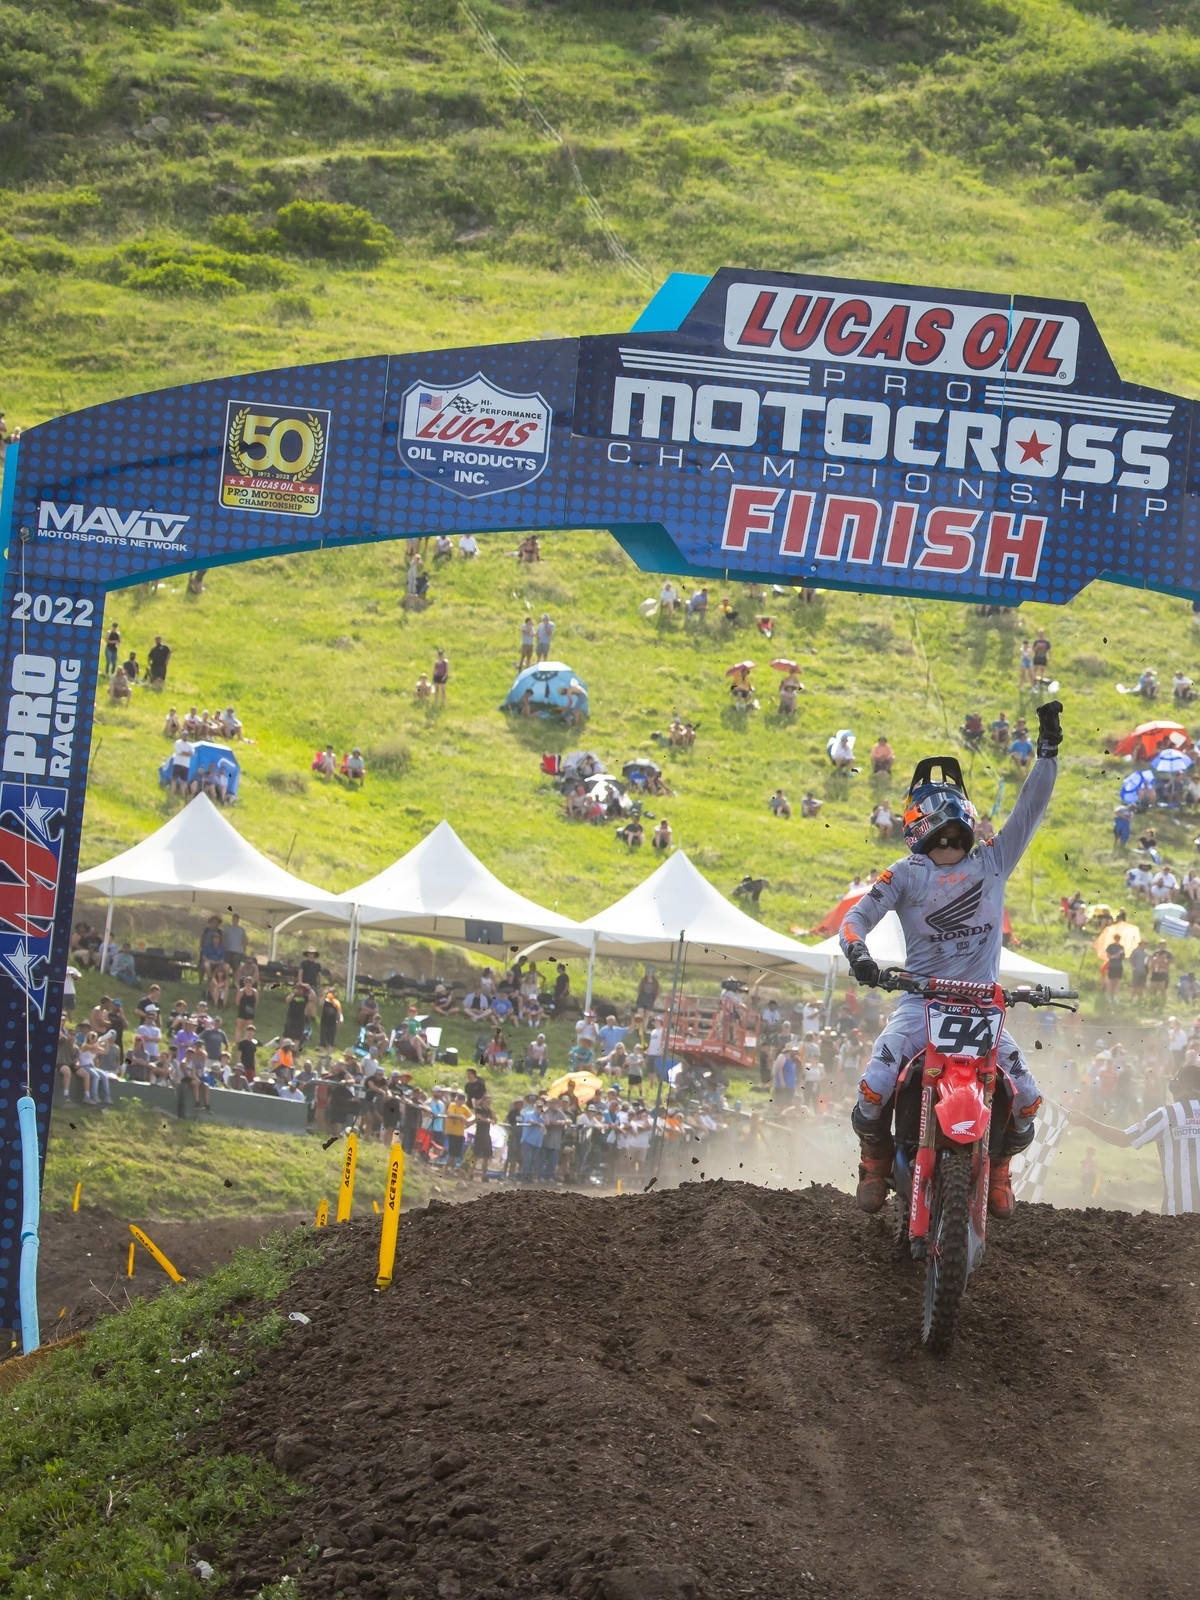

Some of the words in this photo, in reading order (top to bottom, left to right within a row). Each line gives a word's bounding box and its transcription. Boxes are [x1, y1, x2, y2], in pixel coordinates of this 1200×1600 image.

[737, 290, 955, 366] LUCAS
[962, 313, 1065, 378] OIL
[824, 368, 972, 402] PRO
[415, 413, 538, 447] LUCAS
[479, 407, 542, 420] PERFORMANCE
[610, 376, 1174, 490] MOTOCROSS
[239, 414, 315, 474] 50
[407, 446, 437, 461] OIL
[442, 449, 537, 471] PRODUCTS
[227, 487, 249, 497] PRO
[251, 489, 316, 504] MOTOCROSS
[250, 479, 280, 490] LUCAS
[280, 483, 294, 492] OIL
[607, 441, 1168, 517] CHAMPIONSHIP
[238, 497, 303, 511] CHAMPIONSHIP
[37, 529, 127, 546] MOTORSPORTS
[130, 538, 188, 552] NETWORK
[721, 484, 1048, 583] FINISH
[11, 592, 95, 628] 2022
[2, 653, 57, 776] PRO
[49, 658, 82, 779] RACING
[928, 922, 993, 943] HONDA
[935, 978, 994, 990] RENTHAL
[934, 1016, 994, 1058] 94
[344, 1146, 353, 1189] ACERBIS
[388, 1160, 399, 1211] ACERBIS
[911, 1163, 922, 1222] DUNLOP
